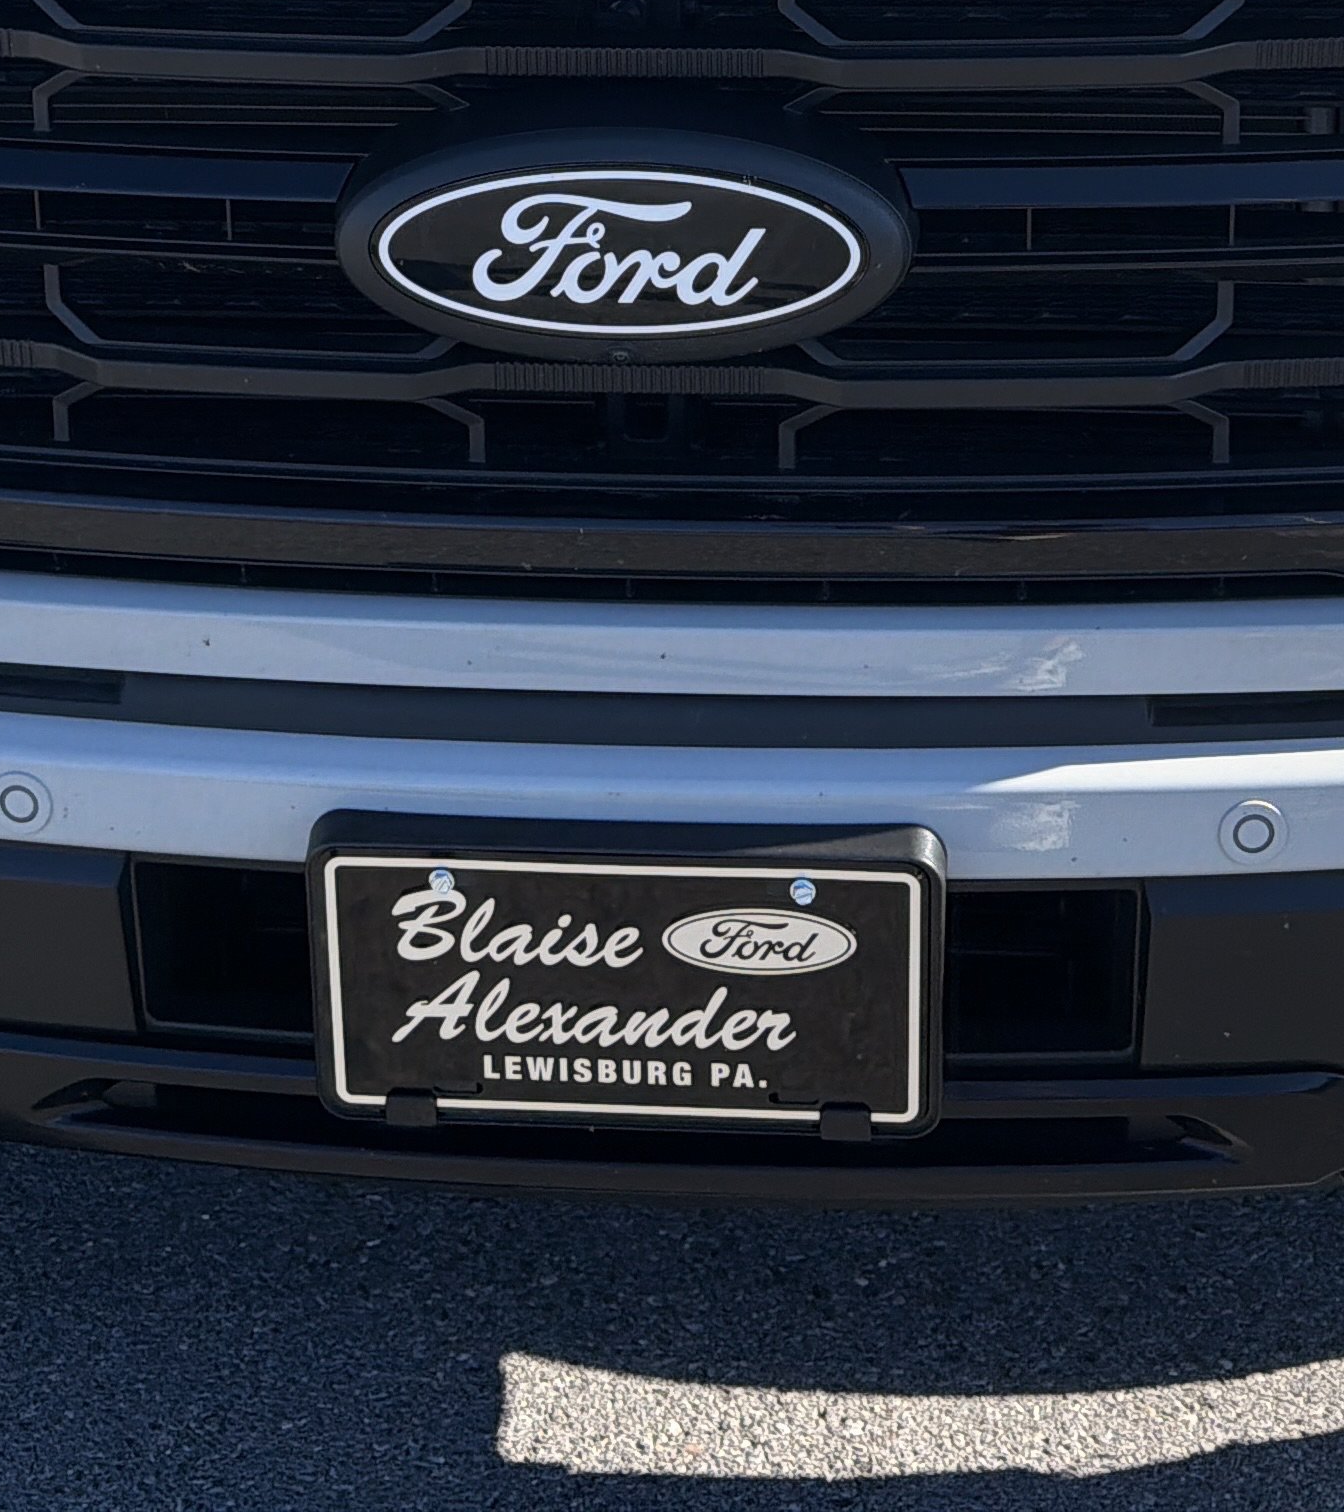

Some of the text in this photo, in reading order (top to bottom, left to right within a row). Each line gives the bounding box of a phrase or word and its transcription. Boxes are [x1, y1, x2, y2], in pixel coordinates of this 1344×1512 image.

[472, 193, 767, 306] Ford
[391, 888, 817, 968] Blaise Ford
[391, 970, 797, 1051] Alexander
[482, 1054, 769, 1089] LEWISBURG PA.
